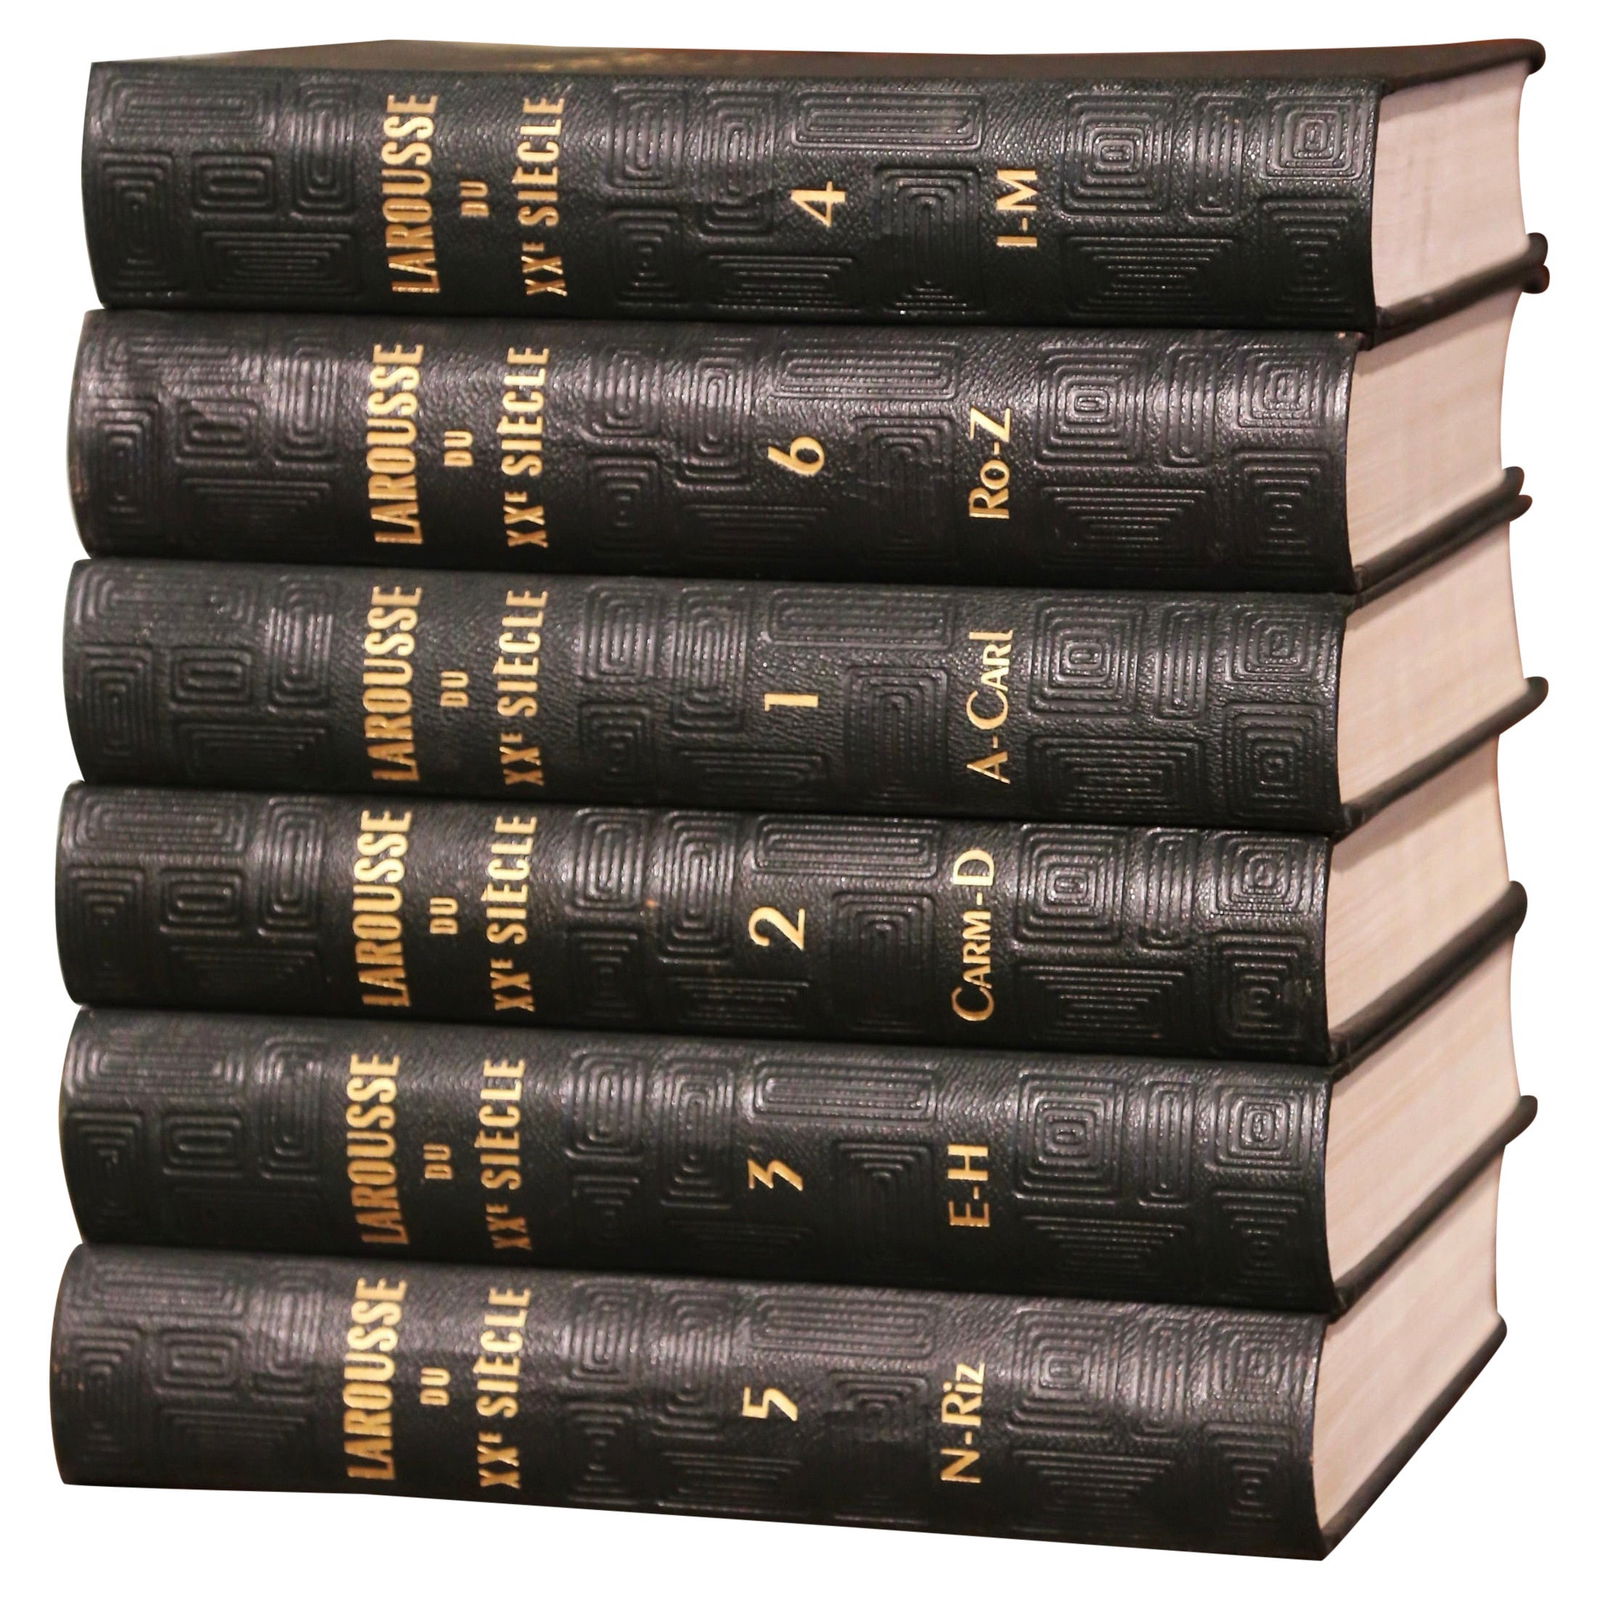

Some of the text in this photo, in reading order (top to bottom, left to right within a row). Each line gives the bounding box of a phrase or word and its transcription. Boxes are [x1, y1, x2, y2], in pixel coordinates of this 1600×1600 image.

[379, 93, 441, 294] LAROUSSE
[458, 180, 491, 218] DU
[511, 97, 566, 228] SIÈCLE
[789, 180, 848, 228] 4
[994, 168, 1039, 248] I-M
[365, 343, 425, 545] LAROUSSE
[442, 428, 475, 468] DU
[495, 346, 551, 477] SIÈCLE
[767, 434, 826, 476] 6
[361, 584, 424, 781] LAROUSSE
[439, 669, 471, 708] DU
[491, 589, 549, 718] SIÈCLE
[762, 691, 820, 713] 1
[351, 809, 414, 1007] LAROUSSE
[427, 895, 460, 935] DU
[479, 815, 539, 945] SIÈCLE
[746, 905, 807, 949] 2
[344, 1052, 408, 1244] LAROUSSE
[422, 1142, 454, 1180] DU
[473, 1058, 527, 1191] SIÈCLE
[746, 1158, 804, 1191] 3
[946, 1143, 991, 1228] E-H
[341, 1276, 409, 1480] LAROUSSE
[418, 1365, 453, 1407] DU
[471, 1287, 533, 1419] SIÈCLE
[741, 1384, 800, 1422] 5
